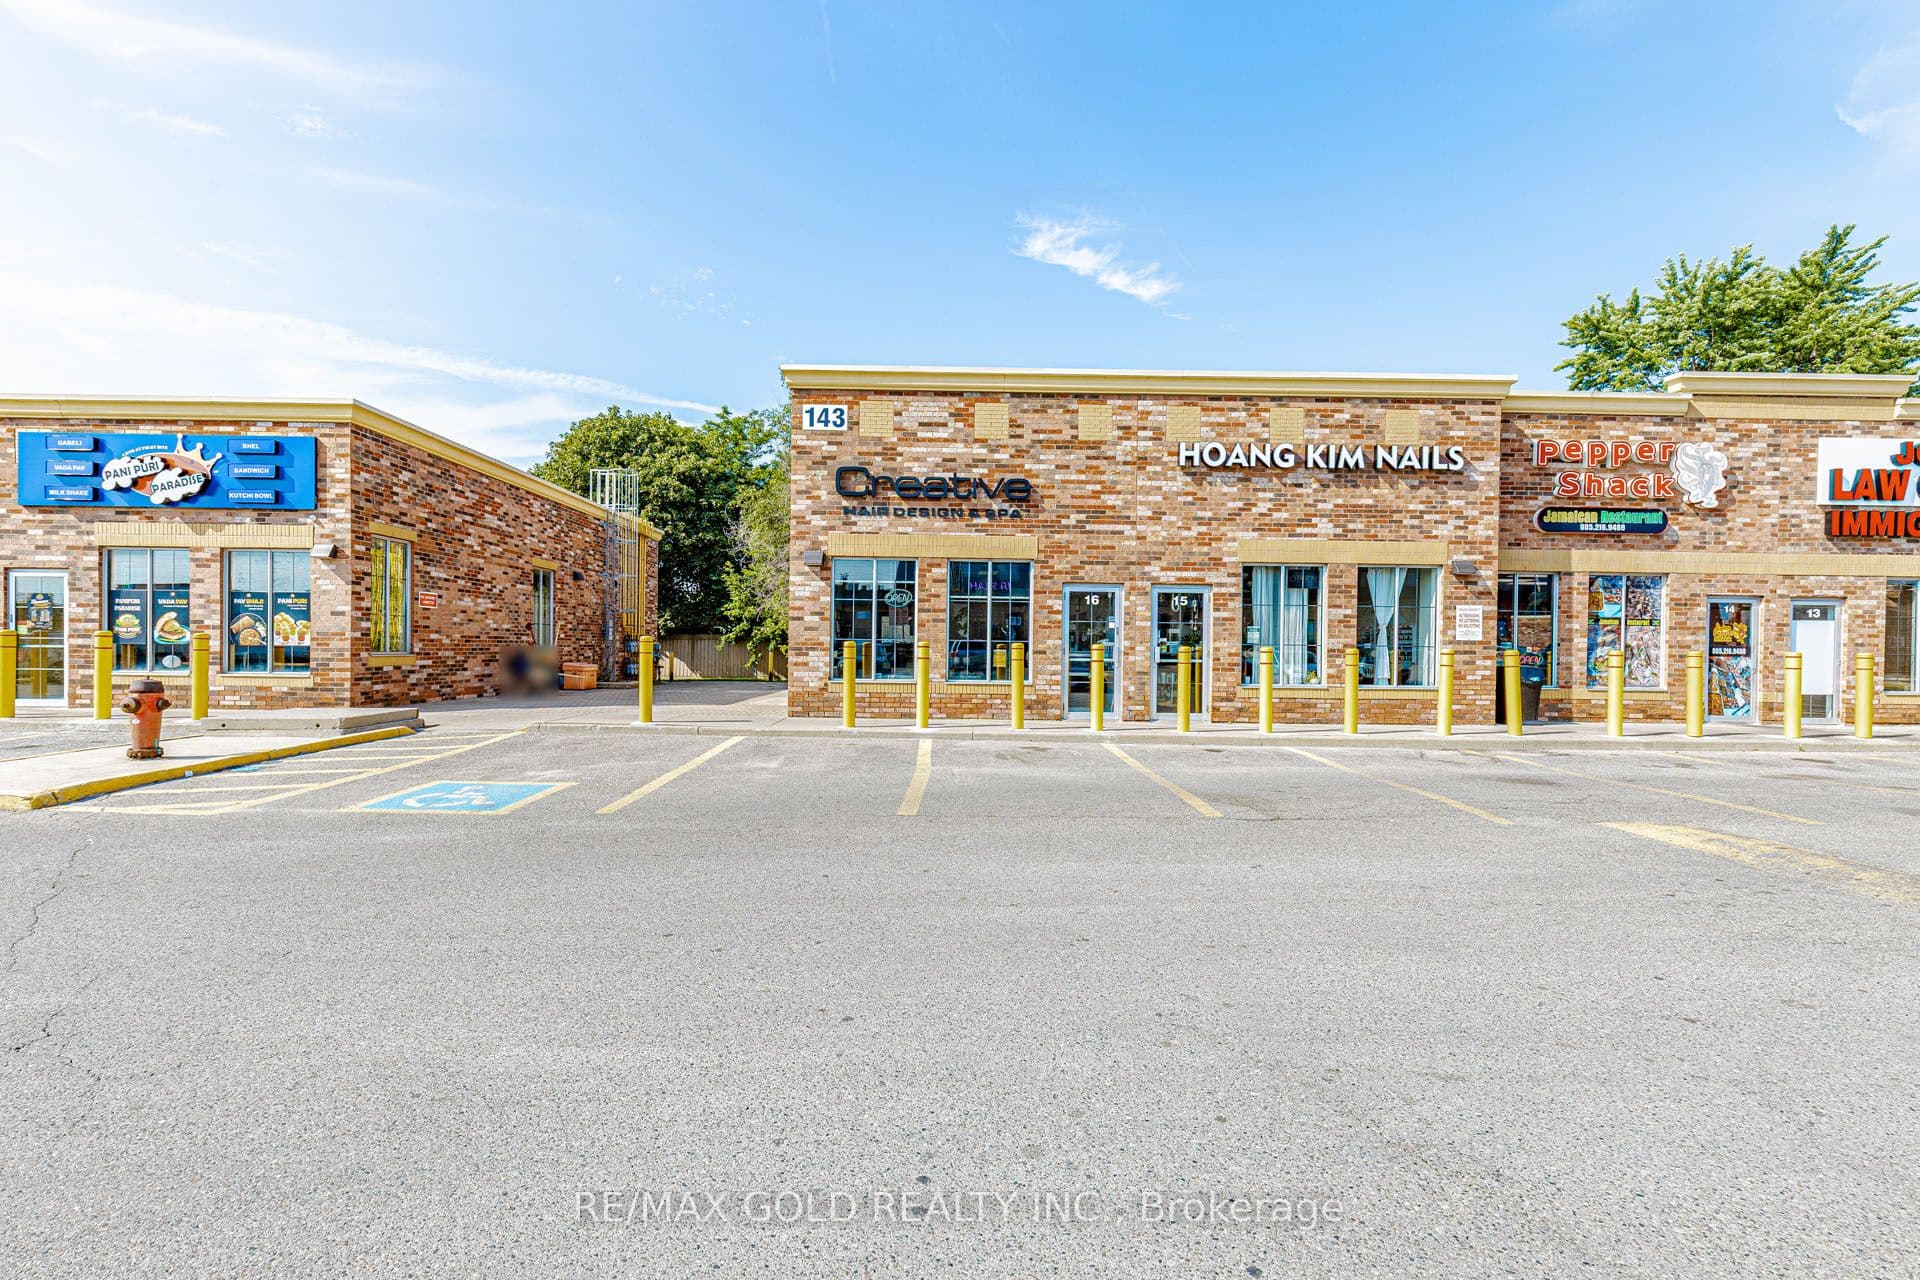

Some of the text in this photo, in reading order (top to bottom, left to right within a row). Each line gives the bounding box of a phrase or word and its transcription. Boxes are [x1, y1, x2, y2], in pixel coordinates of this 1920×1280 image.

[804, 407, 846, 428] 143
[1178, 441, 1465, 471] HOANG KIM NAILS
[1537, 440, 1676, 468] Pepper
[105, 461, 160, 480] PANI PURI
[151, 474, 203, 493] PARADISE
[834, 466, 1034, 500] Creative
[1556, 471, 1676, 498] Shack
[1829, 468, 1911, 501] LAW
[842, 506, 1022, 519] HAIR DESIGN & SPA
[1543, 510, 1663, 524] Jamaican Restaurant
[887, 593, 909, 603] OPEN
[1084, 595, 1099, 605] 16
[1174, 596, 1188, 606] 15
[1724, 605, 1735, 613] 14
[1806, 608, 1821, 618] 13
[1520, 655, 1541, 665] OPEN
